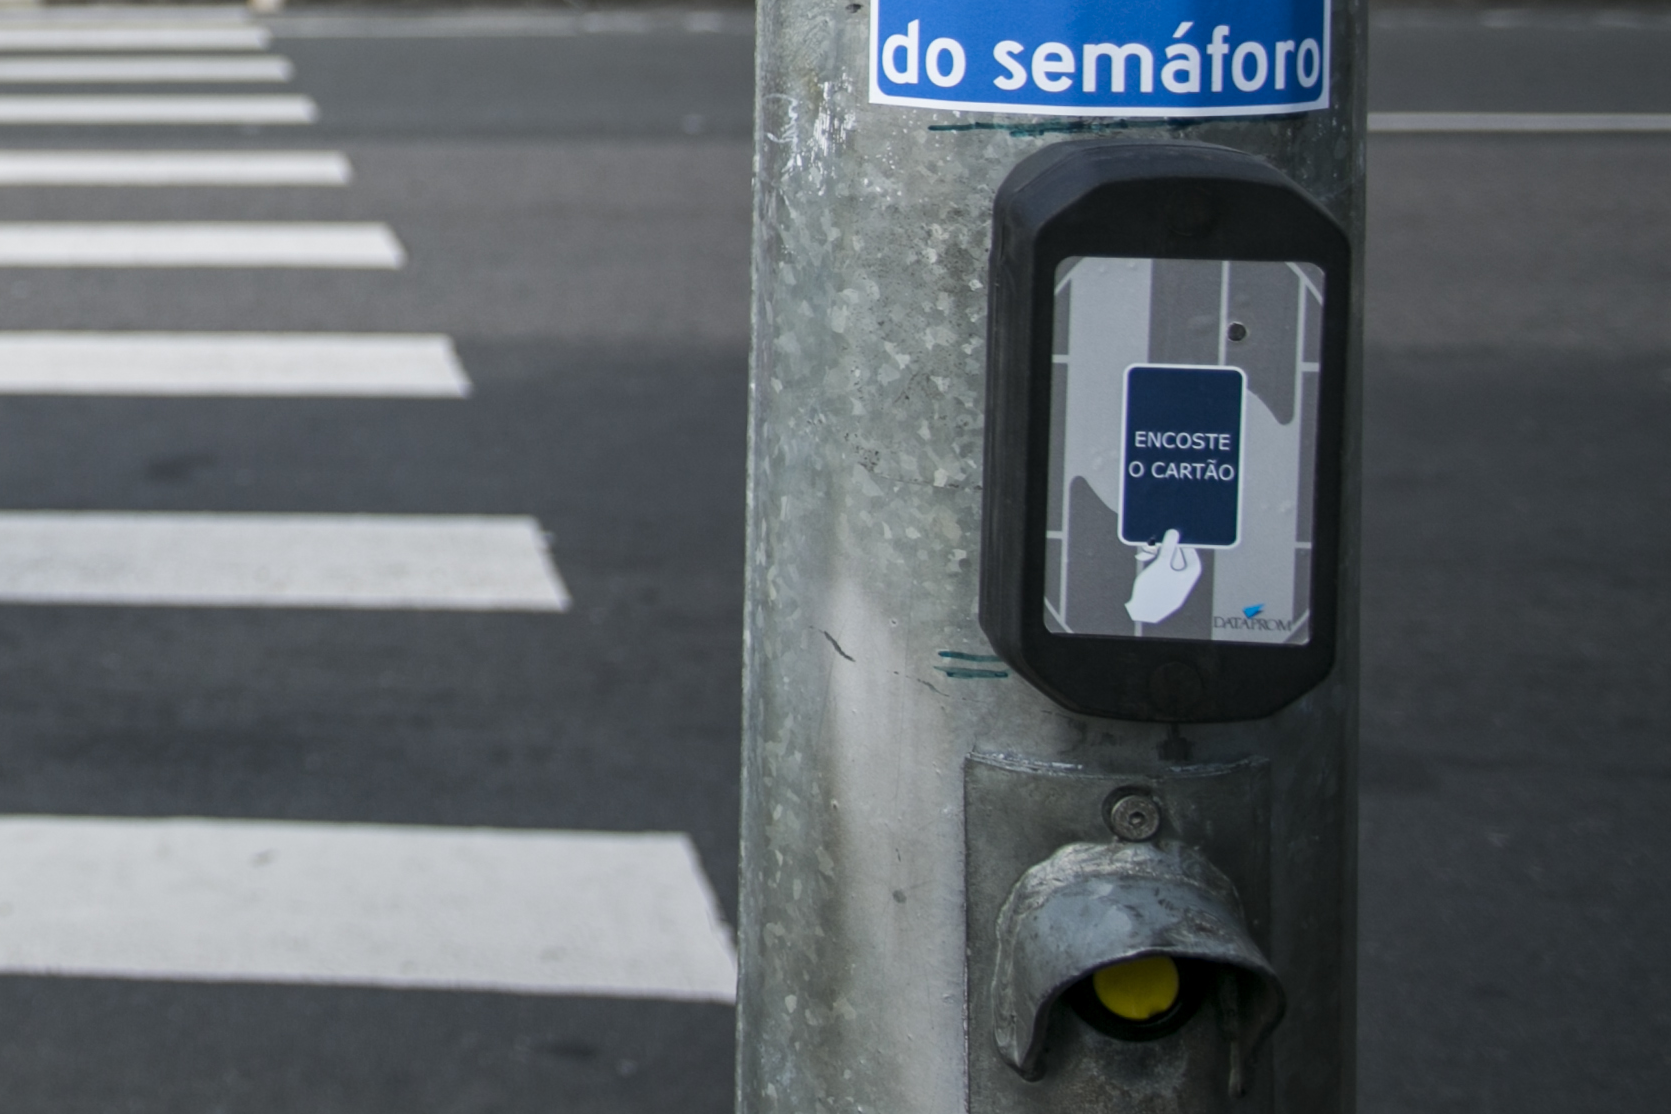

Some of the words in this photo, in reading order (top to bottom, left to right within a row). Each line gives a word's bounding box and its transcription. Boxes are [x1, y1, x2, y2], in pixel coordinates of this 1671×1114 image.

[881, 18, 968, 89] do
[992, 21, 1320, 95] semáforo
[1134, 431, 1231, 451] ENCOSTE
[1128, 461, 1145, 478] O
[1151, 459, 1235, 481] CARTÃO
[1213, 616, 1293, 632] DATAPROM
